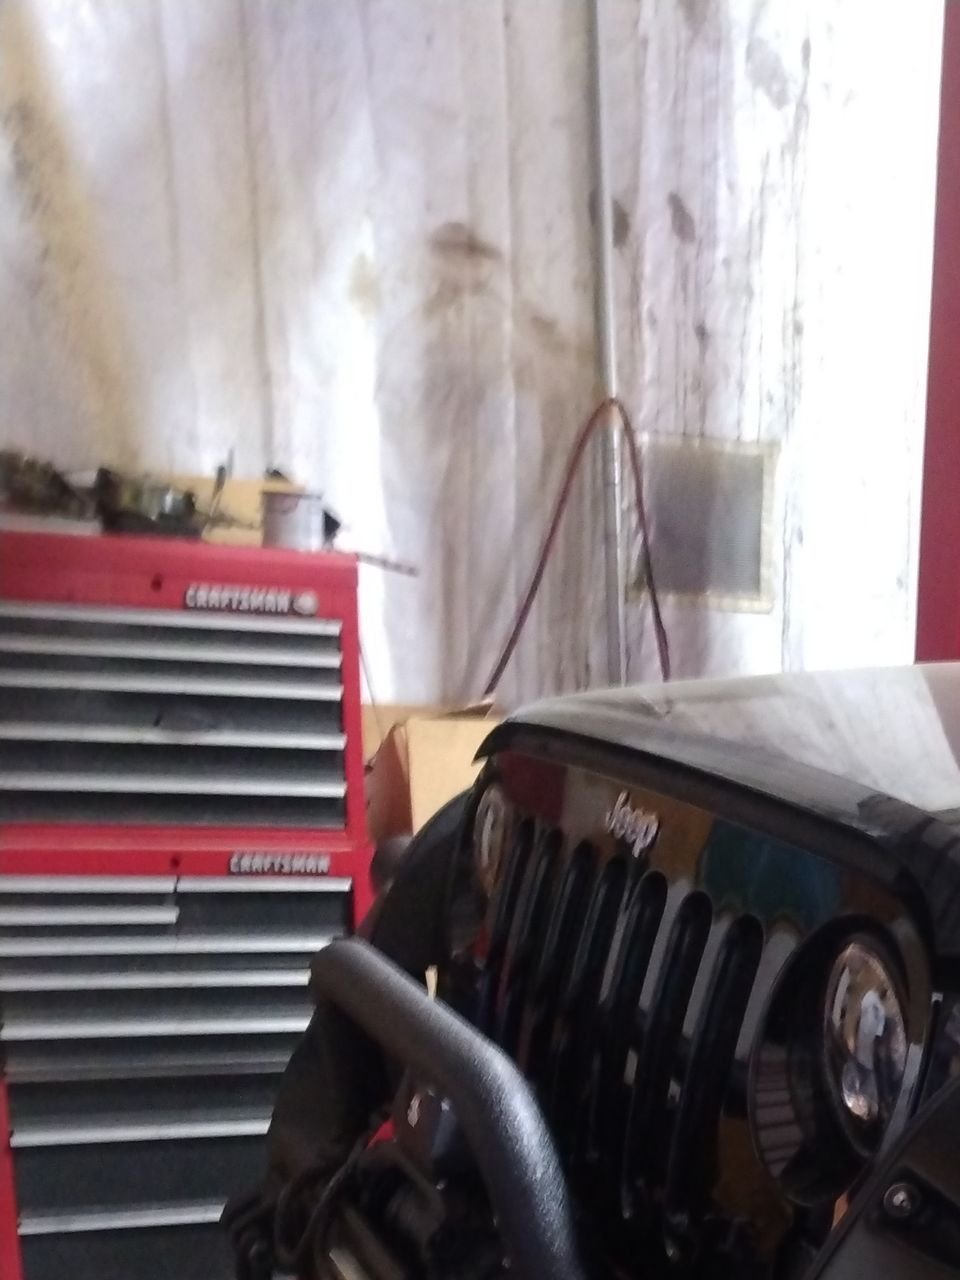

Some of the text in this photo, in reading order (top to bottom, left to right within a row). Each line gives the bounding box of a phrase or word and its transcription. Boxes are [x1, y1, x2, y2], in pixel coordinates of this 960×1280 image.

[185, 584, 291, 613] CRAFTSMAN
[605, 790, 660, 858] Jeep
[230, 853, 331, 874] CRAFTSMAN
